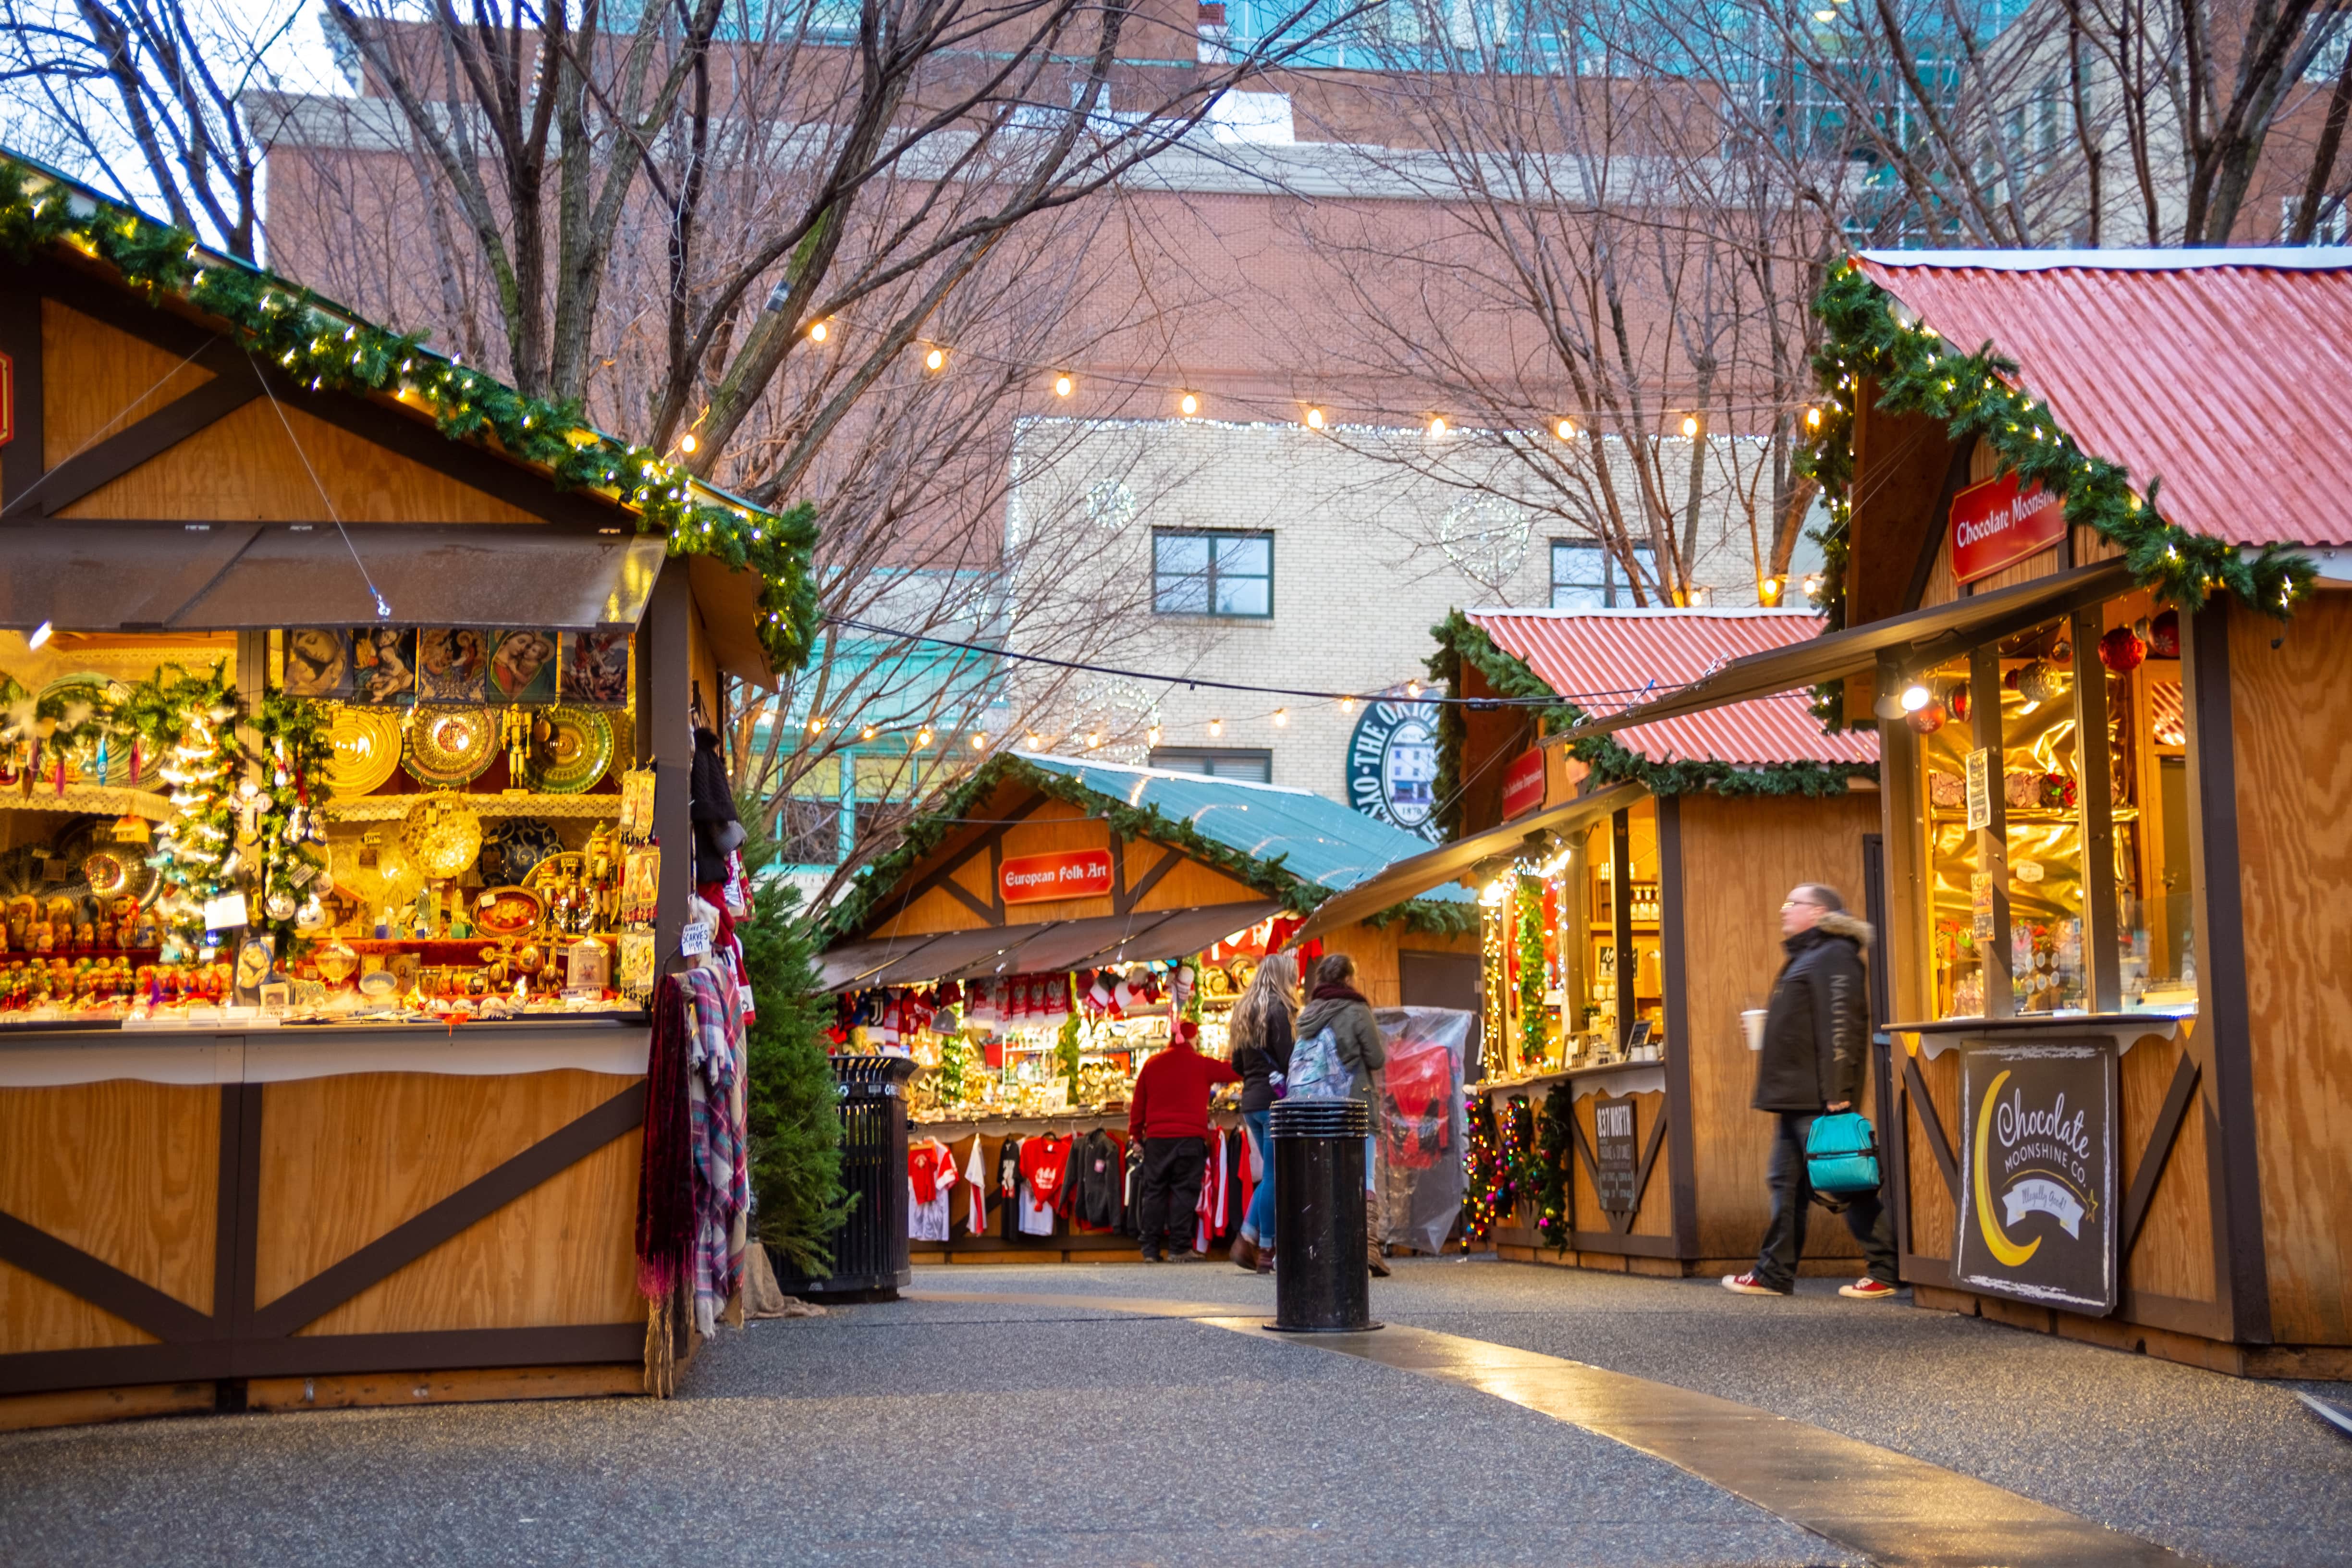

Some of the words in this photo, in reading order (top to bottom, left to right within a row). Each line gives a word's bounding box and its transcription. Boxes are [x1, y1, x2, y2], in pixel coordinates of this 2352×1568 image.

[1957, 510, 2009, 548] Chocolate
[1353, 720, 1389, 767] THE
[1005, 871, 1055, 887] European
[1059, 866, 1084, 883] Folk
[1087, 862, 1107, 878] Art
[683, 930, 708, 944] SCARVES
[1829, 974, 1850, 1062] NAUTICA
[1596, 1107, 1610, 1138] 837
[1610, 1105, 1631, 1137] NORTH
[1997, 1087, 2090, 1159] Chocolate
[2005, 1143, 2068, 1173] MOONSHINE
[2071, 1160, 2087, 1188] CO.
[2021, 1185, 2047, 1207] Illegally
[2048, 1190, 2067, 1210] Good!
